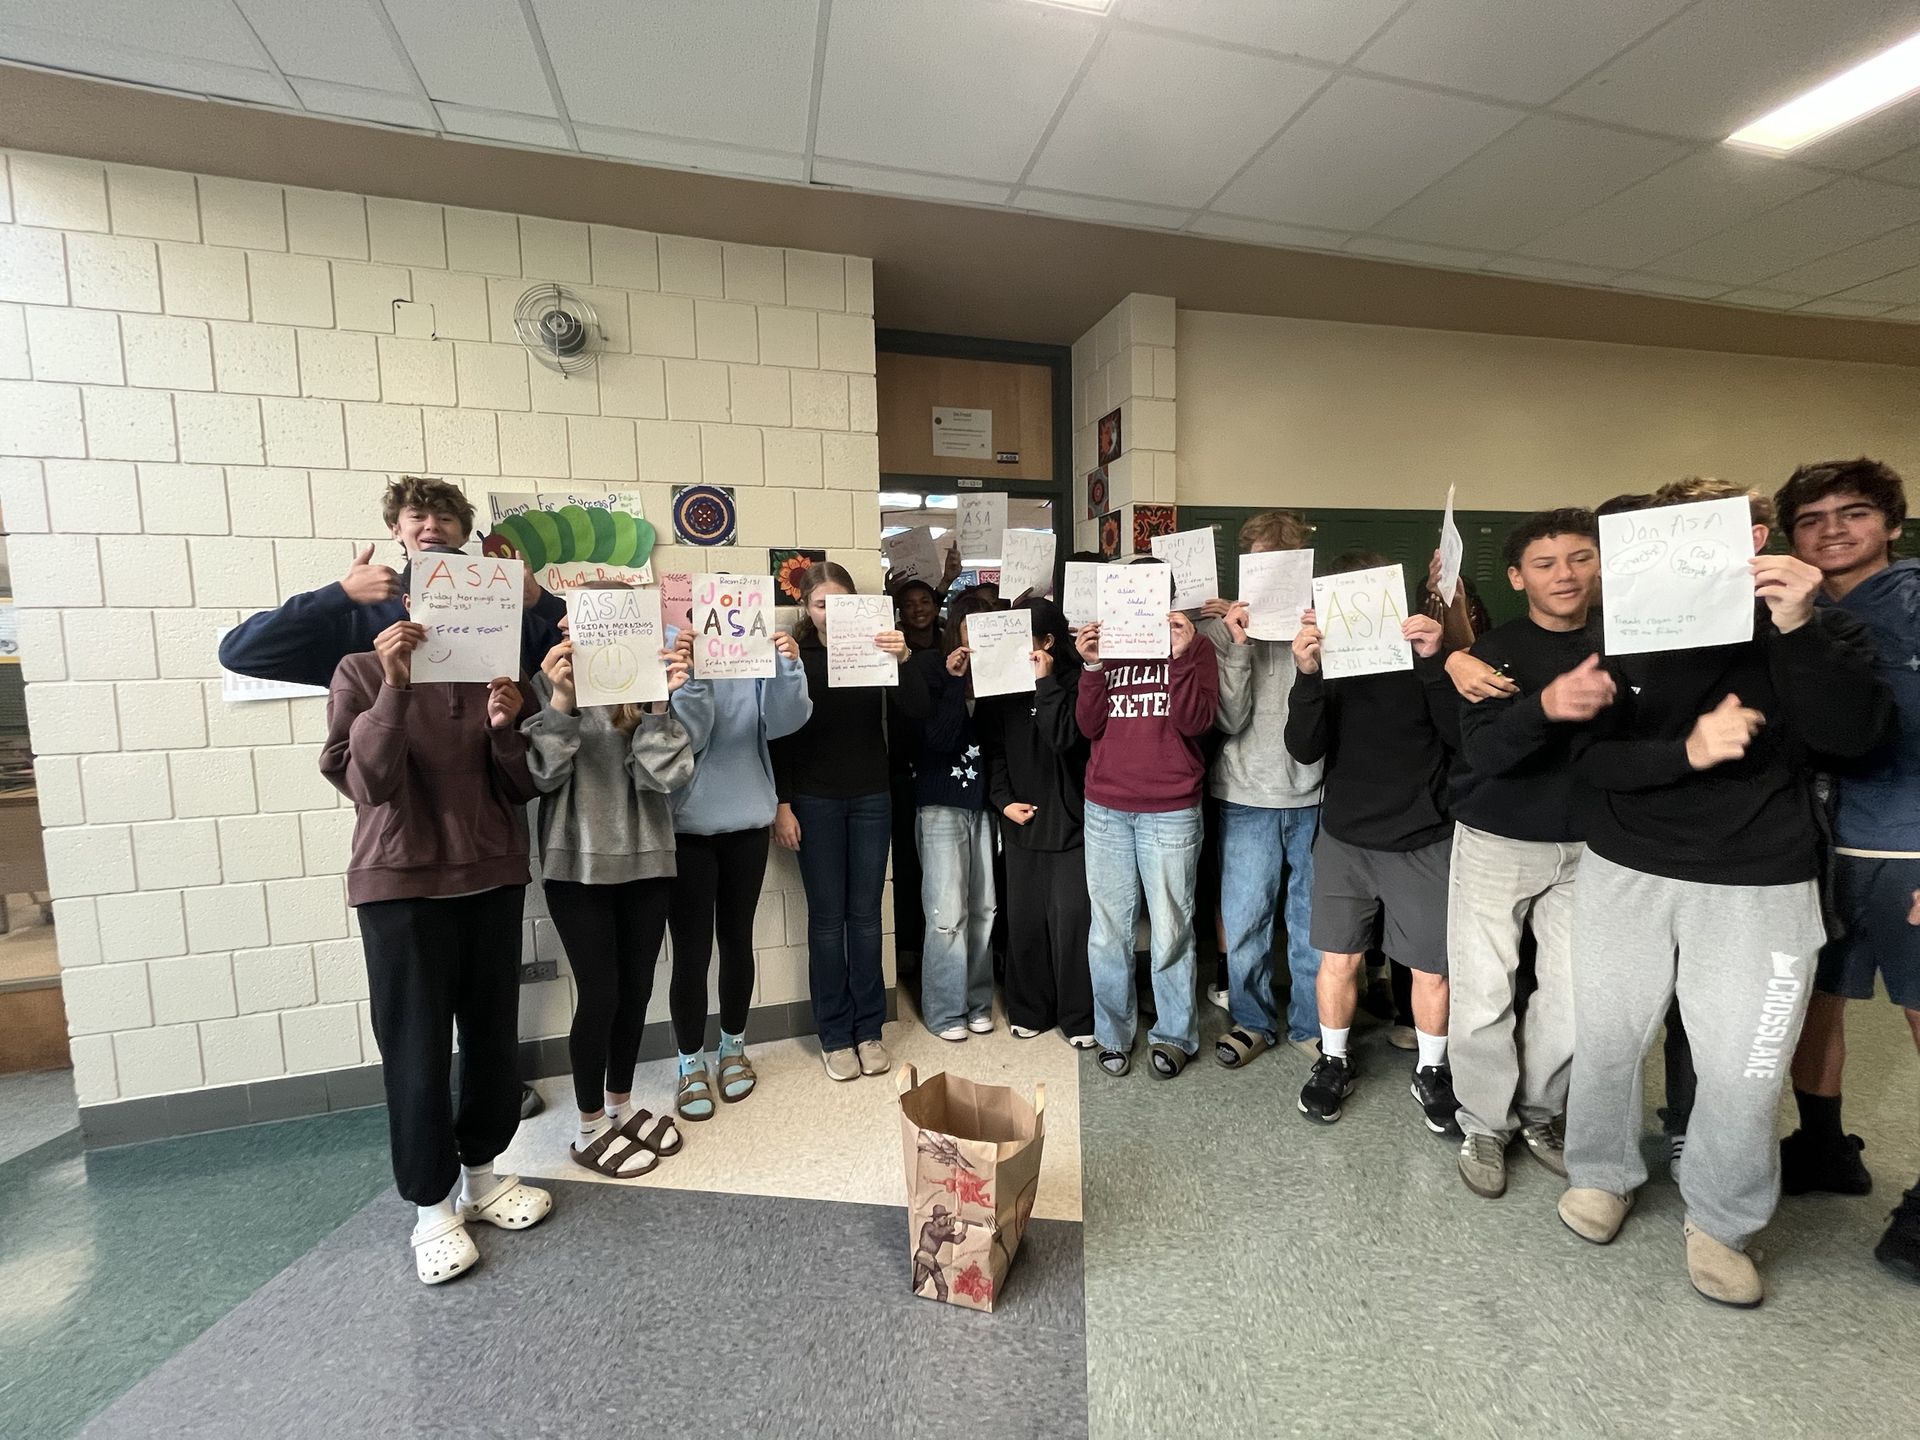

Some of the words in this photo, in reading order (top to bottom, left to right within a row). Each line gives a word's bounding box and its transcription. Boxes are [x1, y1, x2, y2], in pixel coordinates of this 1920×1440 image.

[490, 494, 530, 521] Hungry
[537, 494, 555, 516] For
[1671, 512, 1723, 538] ASA
[426, 560, 512, 589] ASA
[421, 591, 453, 605] Friday
[575, 592, 641, 624] ASA
[700, 581, 763, 608] Join
[855, 597, 891, 616] ASA
[576, 623, 609, 631] FRIDAY
[612, 621, 654, 629] MORNINGS
[703, 607, 768, 638] ASA
[1323, 588, 1403, 641] ASA
[607, 629, 629, 638] FREE
[1743, 978, 1801, 1079] CROSSLAKE
